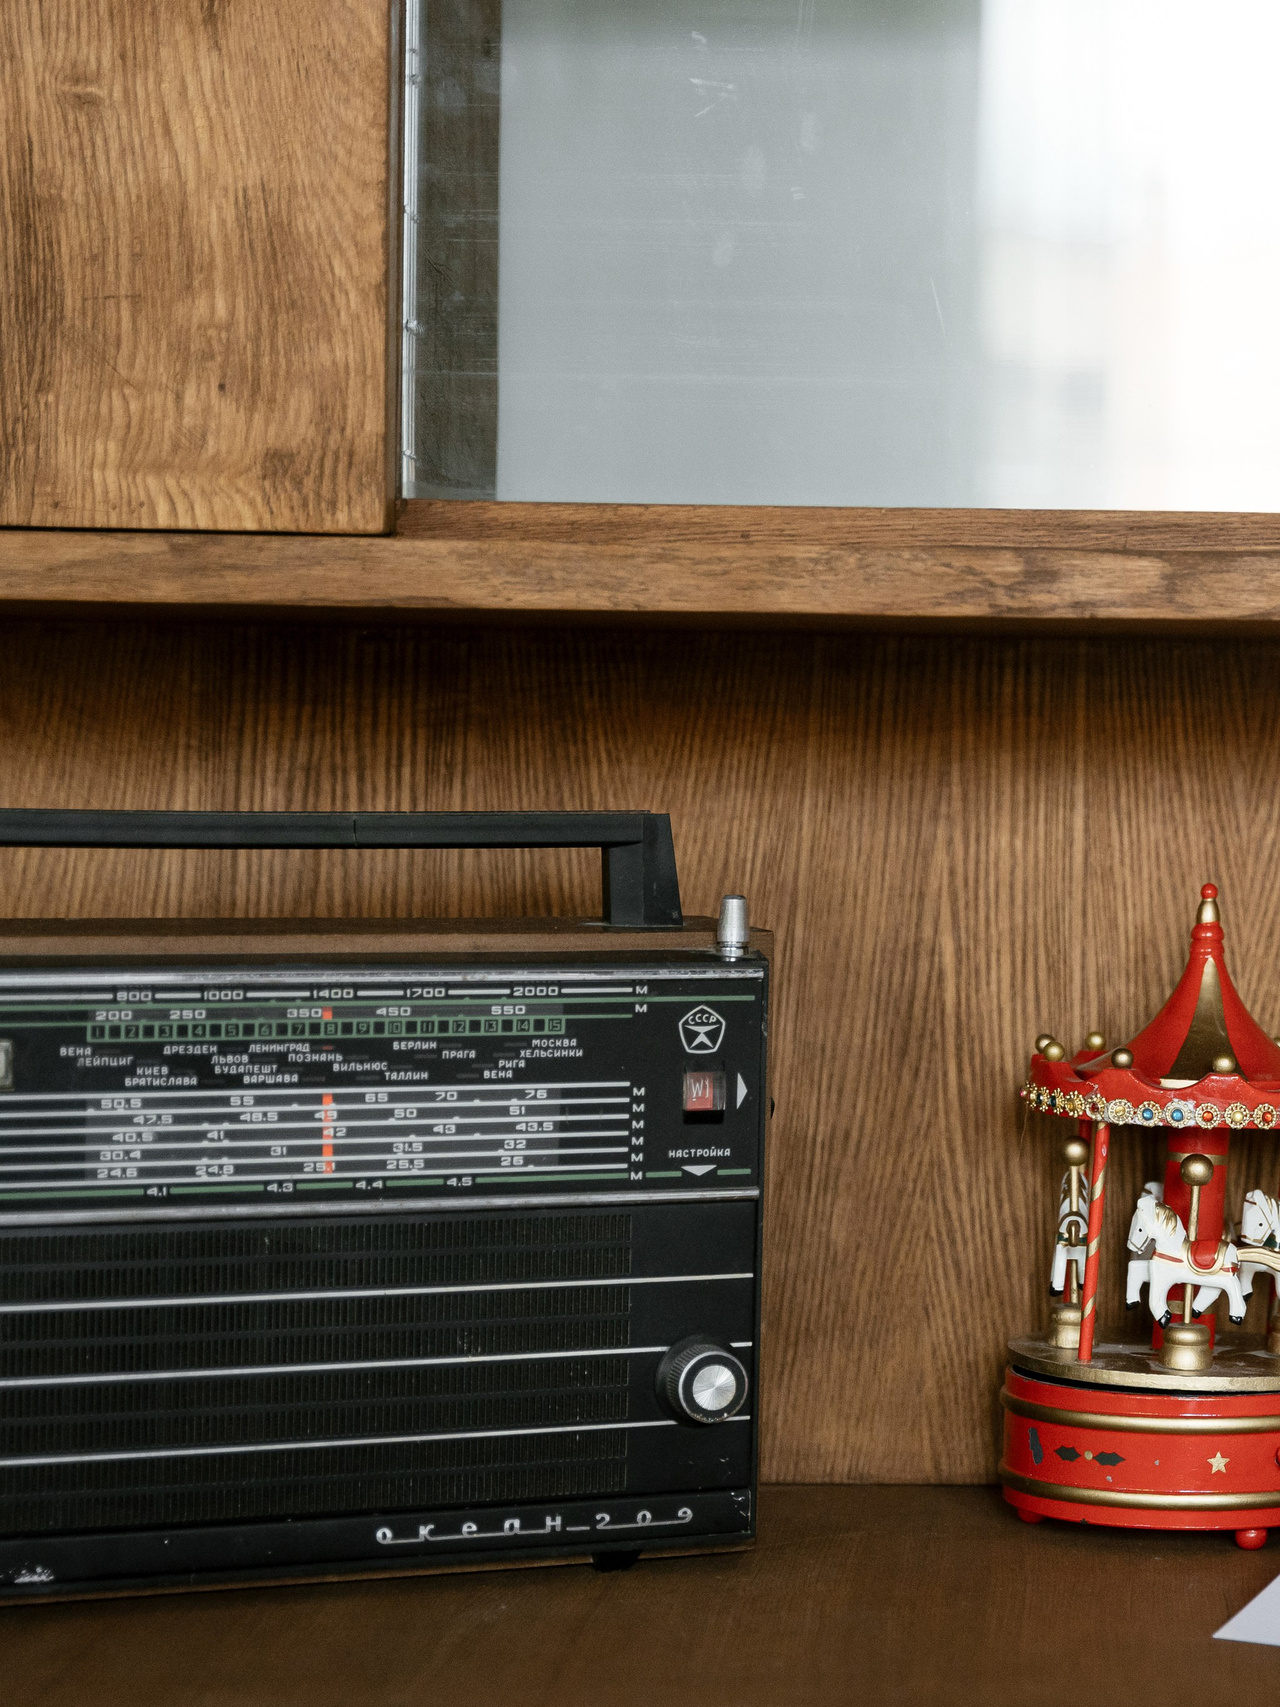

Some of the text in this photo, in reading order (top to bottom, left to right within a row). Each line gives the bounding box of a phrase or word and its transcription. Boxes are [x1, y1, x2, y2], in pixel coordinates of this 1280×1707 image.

[116, 991, 152, 1001] 800
[203, 990, 244, 1000] 1000
[312, 989, 354, 999] 1400
[406, 988, 446, 998] 1700
[513, 986, 559, 996] 2000
[95, 1010, 132, 1021] 200
[169, 1009, 207, 1020] 250
[286, 1008, 322, 1018] 350
[375, 1007, 411, 1016] 450
[491, 1005, 526, 1015] 550
[688, 1012, 717, 1025] СССР
[127, 1026, 136, 1038] 2
[161, 1026, 169, 1037] 3
[194, 1025, 203, 1036] 4
[227, 1025, 236, 1036] 5
[260, 1025, 270, 1036] 6
[295, 1024, 303, 1035] 7
[326, 1024, 335, 1034] 8
[359, 1023, 367, 1034] 9
[389, 1022, 401, 1033] 10
[422, 1022, 432, 1032] 11
[453, 1021, 465, 1032] 12
[485, 1020, 496, 1032] 13
[517, 1020, 529, 1031] 14
[549, 1020, 561, 1031] 15
[60, 1038, 577, 1057] ВЕНА ДРЕЗДЕН ЛЕНИНГРАД БЕРЛИН МОСКВА
[77, 1049, 584, 1067] ЛЕЙПЦИГ ЛЬВОВ ПОЗНАНЬ ПРАГА ХЕЛЬСИНКИ
[136, 1059, 526, 1076] КИЕВ БУДАПЕШТ ВИЛЬНЮС РИГА
[124, 1070, 513, 1087] БРАТИСЛАВА ВАРШАВА ТАЛЛИН ВЕНА
[101, 1098, 142, 1109] 50.5
[230, 1095, 254, 1106] 55
[365, 1093, 388, 1103] 65
[435, 1091, 458, 1101] 70
[524, 1089, 548, 1099] 76
[133, 1114, 173, 1125] 47.5
[240, 1111, 278, 1122] 48.5
[314, 1110, 338, 1120] 49
[394, 1108, 417, 1118] 50
[508, 1106, 526, 1116] 51
[112, 1132, 153, 1142] 40.5
[206, 1130, 225, 1140] 41
[323, 1127, 347, 1137] 42
[432, 1124, 456, 1134] 43
[515, 1122, 554, 1132] 43.5
[100, 1150, 141, 1161] 30.4
[270, 1146, 287, 1156] 31
[392, 1142, 423, 1153] 31.5
[504, 1139, 526, 1149] 32
[668, 1147, 731, 1158] НАСТРОЙКА
[97, 1168, 138, 1178] 24.6
[195, 1165, 234, 1176] 24.8
[303, 1162, 335, 1172] 25.1
[386, 1159, 425, 1170] 25.5
[501, 1156, 524, 1166] 26
[146, 1186, 167, 1197] 4.1
[266, 1183, 293, 1193] 4.3
[355, 1180, 383, 1190] 4.4
[446, 1177, 473, 1187] 4.5
